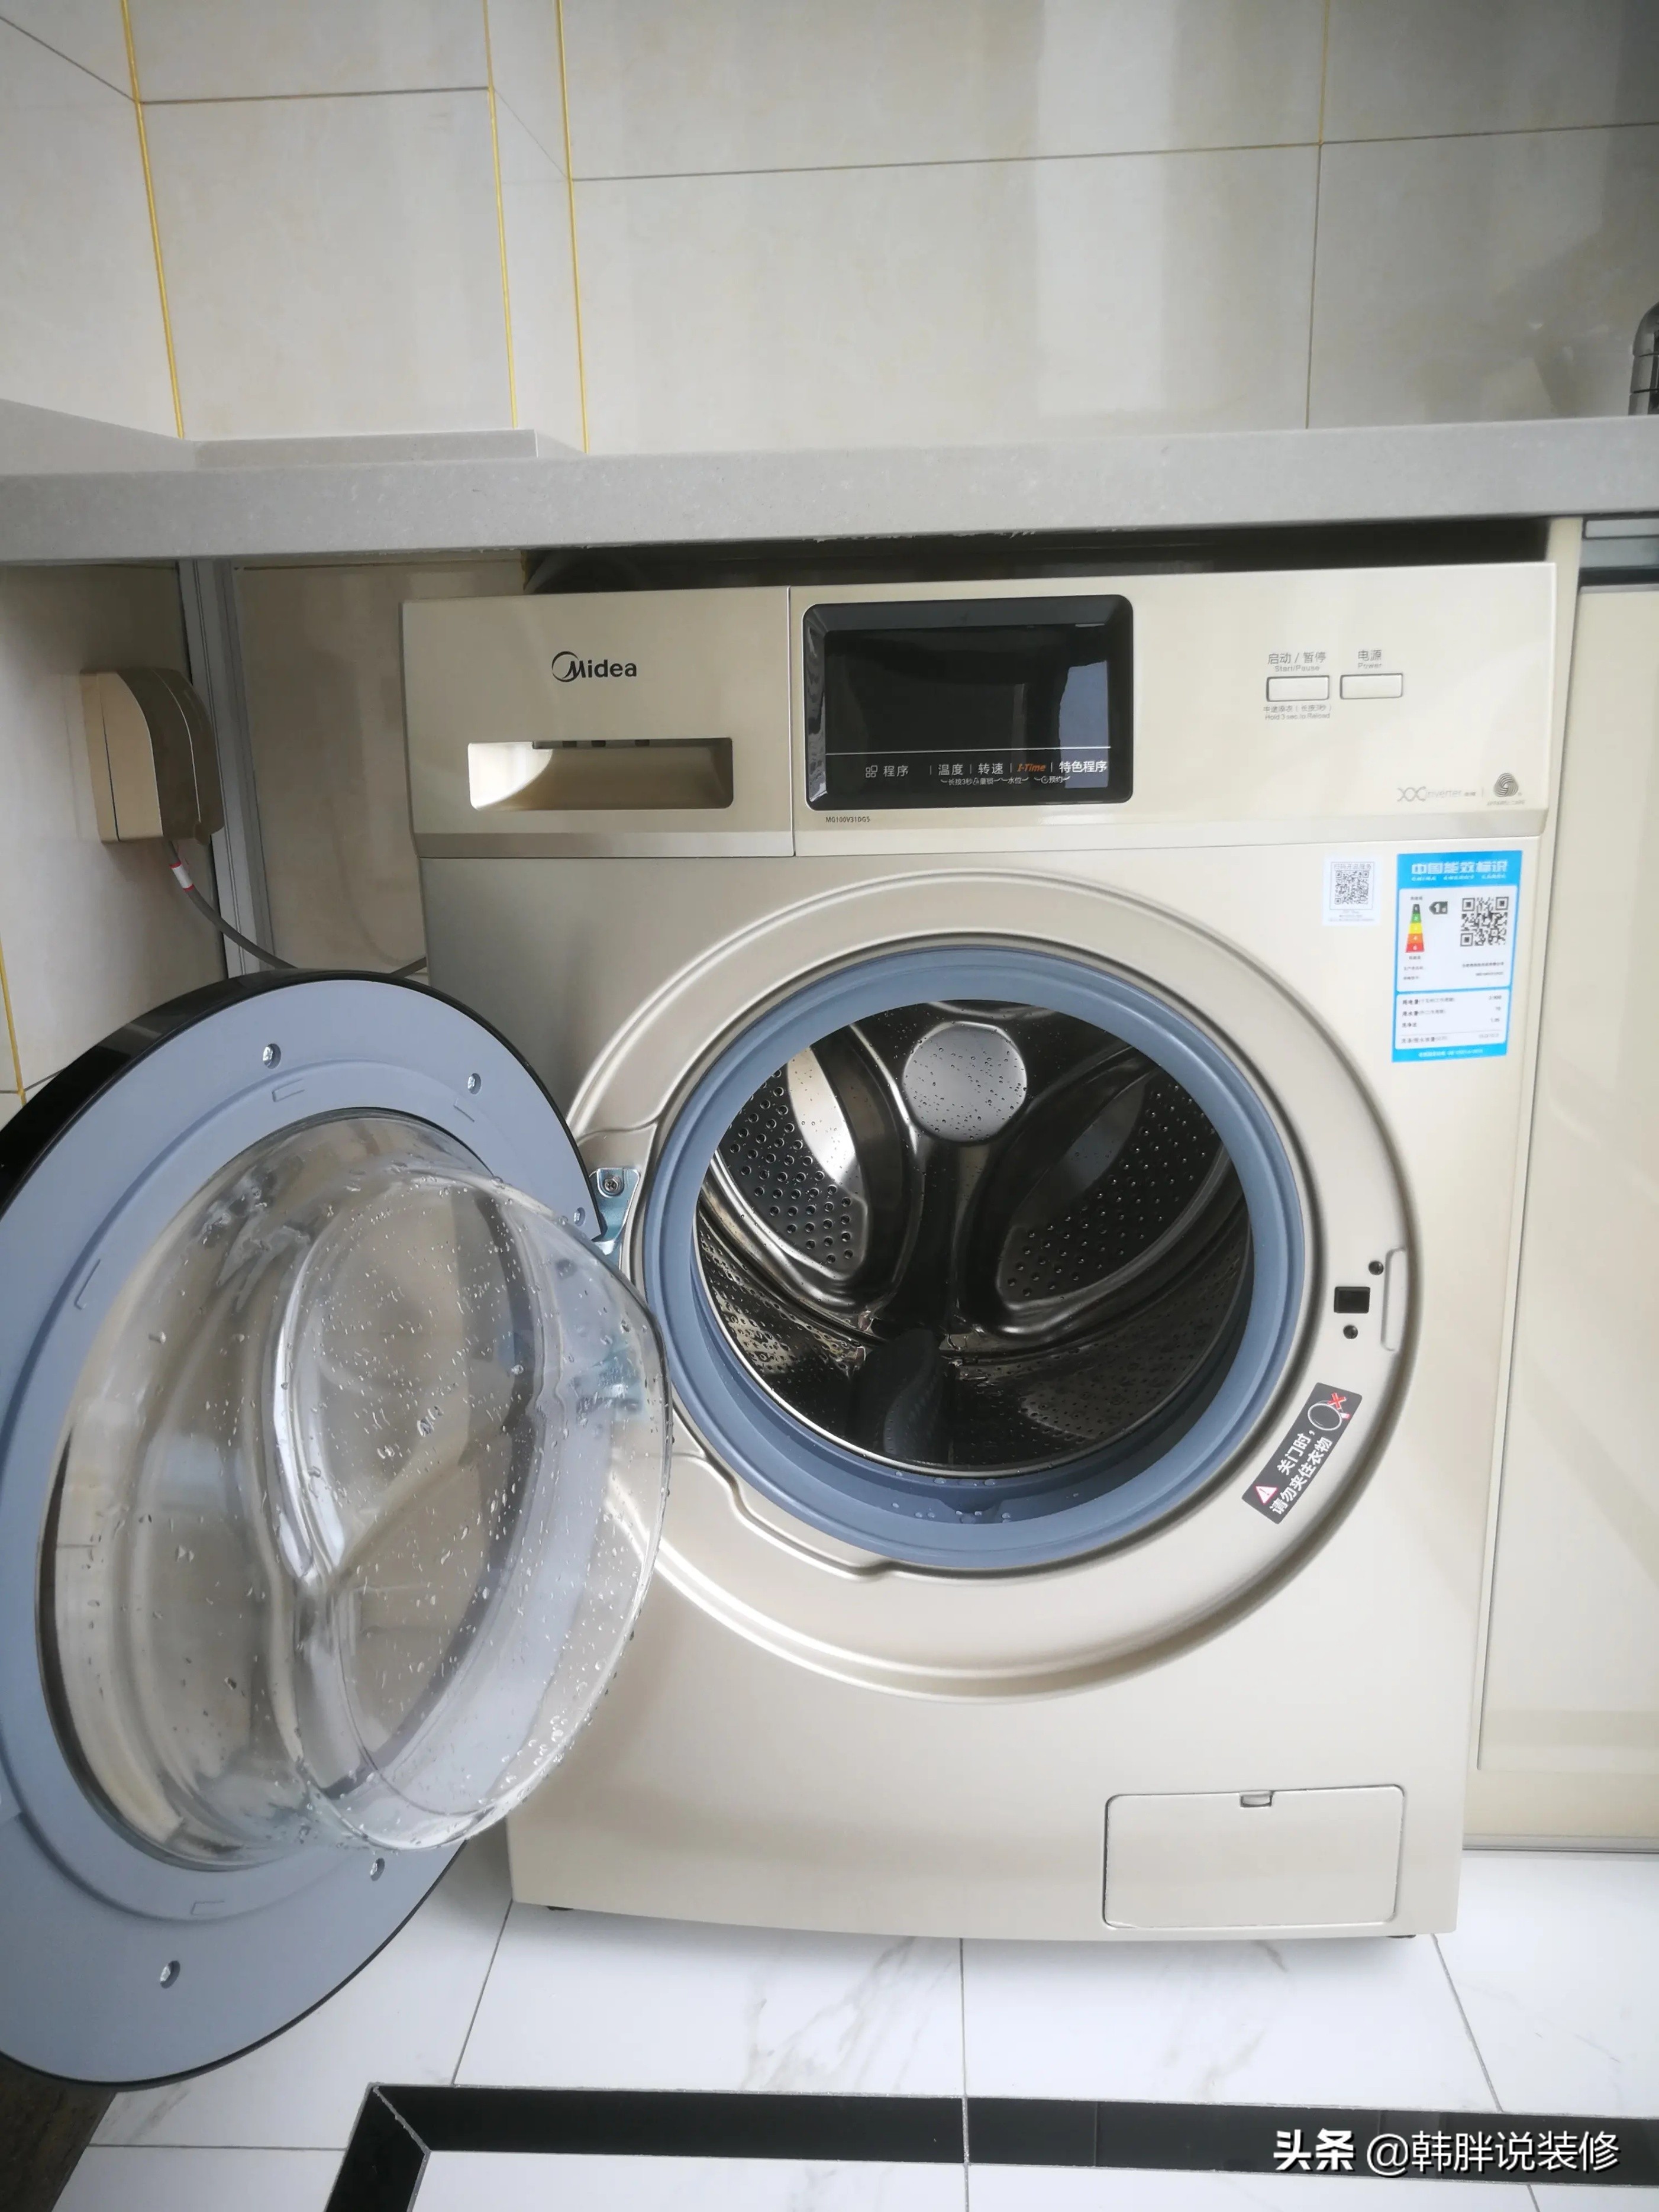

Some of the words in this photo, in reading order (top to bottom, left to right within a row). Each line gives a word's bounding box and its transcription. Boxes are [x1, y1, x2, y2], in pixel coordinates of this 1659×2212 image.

[1357, 649, 1383, 662] 电源
[551, 650, 637, 683] Midea
[1274, 664, 1321, 672] Start/Pause
[883, 765, 909, 777] 程序
[938, 764, 963, 776] 温度
[978, 763, 1003, 775] 转速
[1058, 760, 1108, 774] 特色程序
[1008, 776, 1022, 784] 水位
[1048, 775, 1063, 783] 预约
[1269, 1436, 1332, 1515] 请勿夹住衣物
